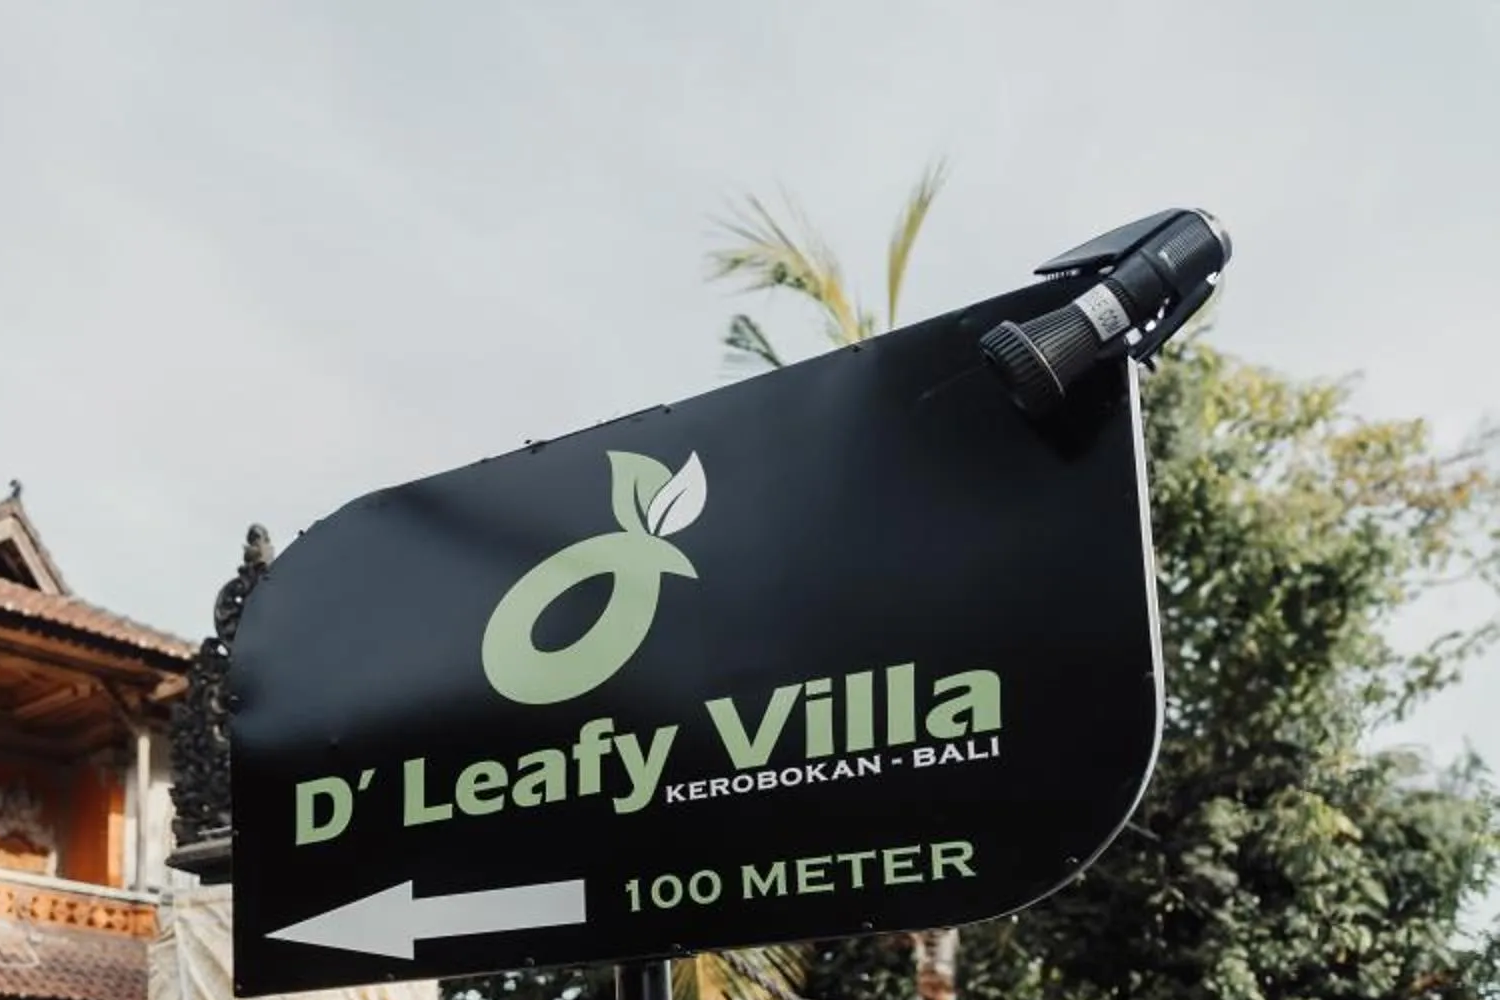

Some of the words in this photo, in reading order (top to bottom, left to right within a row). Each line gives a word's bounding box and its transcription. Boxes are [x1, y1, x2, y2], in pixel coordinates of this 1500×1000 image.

[403, 717, 679, 827] Leafy
[704, 662, 1002, 770] Villa
[665, 754, 882, 804] KEROBOKAN
[912, 735, 1000, 769] BALI
[624, 869, 722, 912] 100
[741, 841, 977, 899] METER
